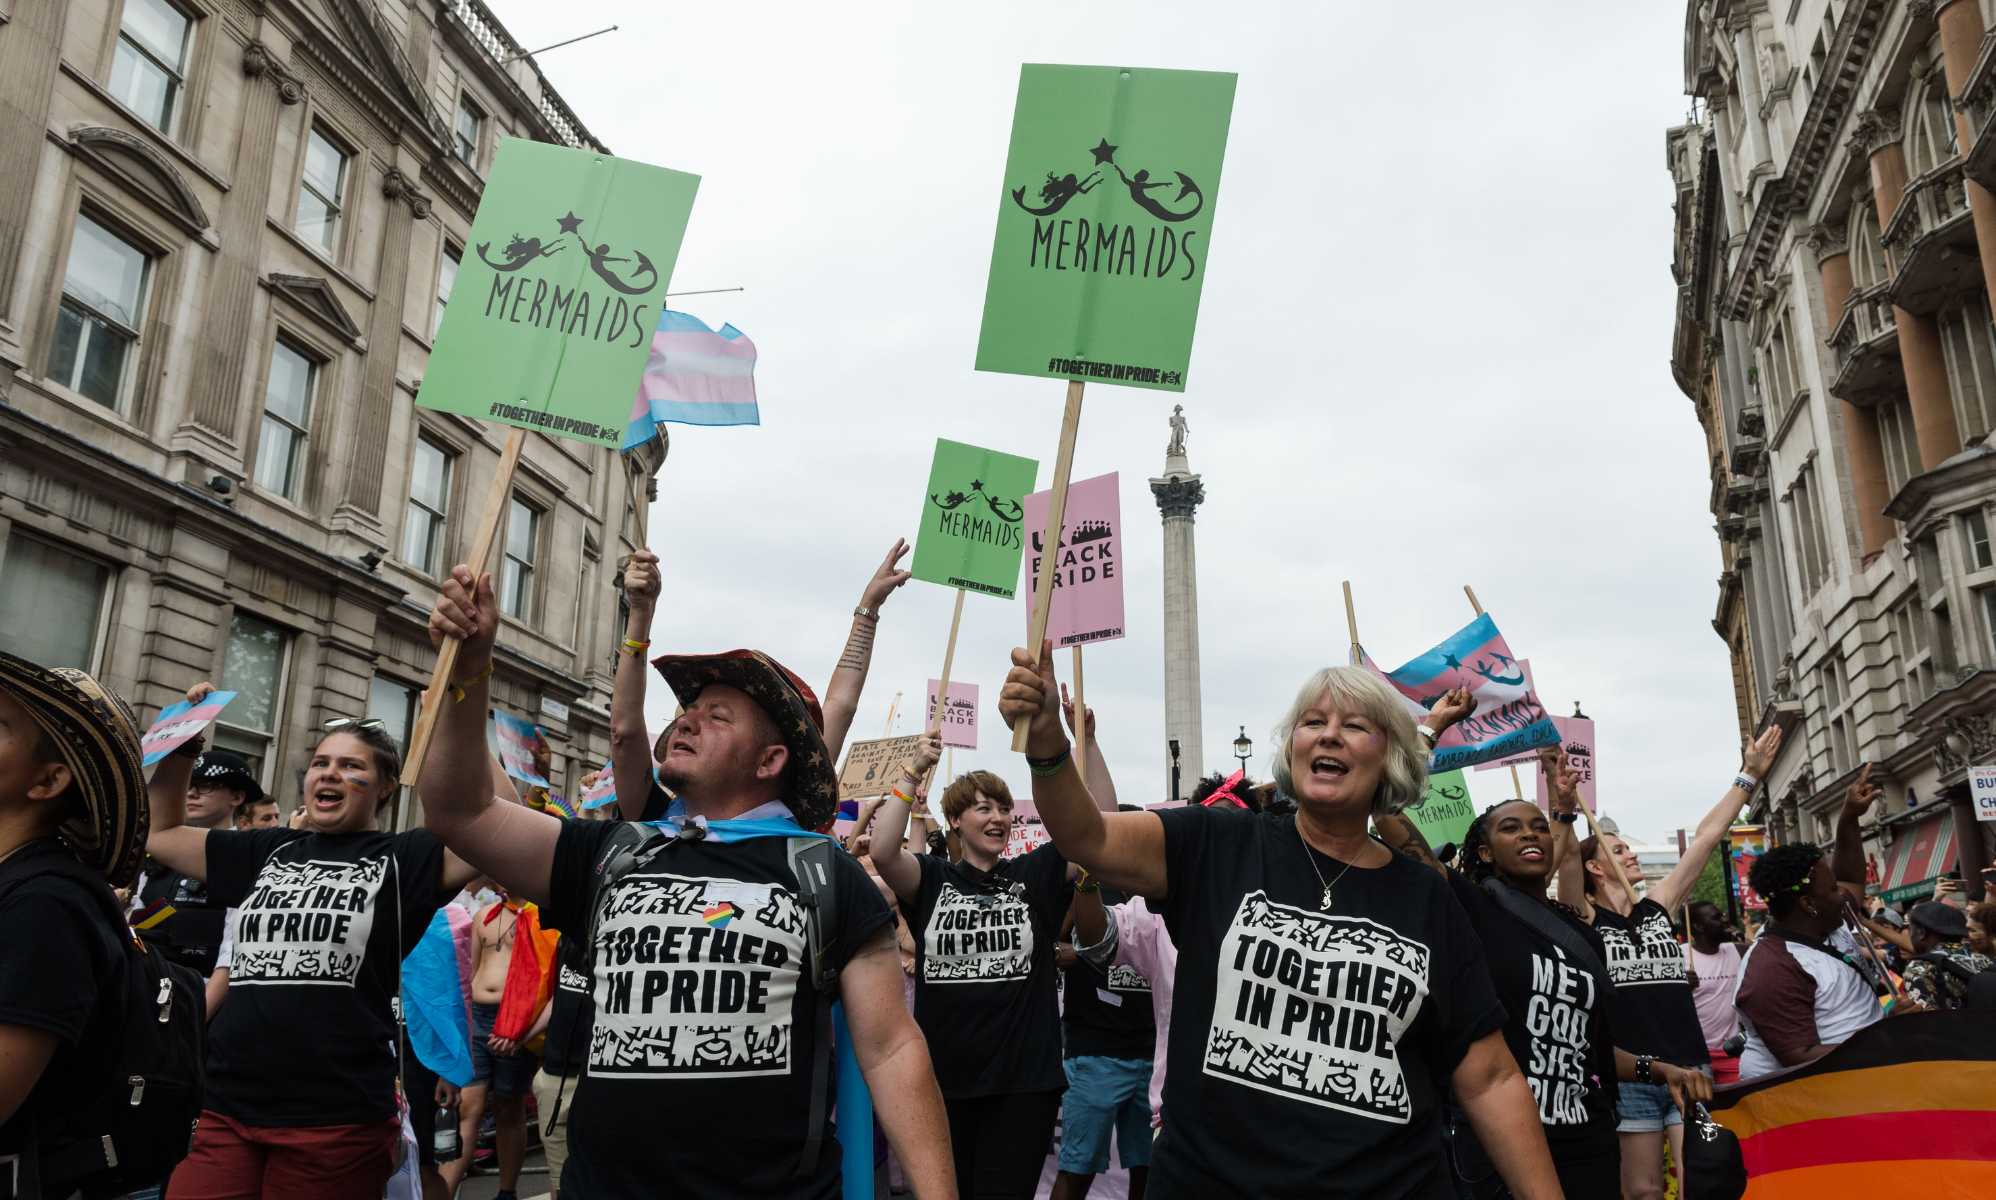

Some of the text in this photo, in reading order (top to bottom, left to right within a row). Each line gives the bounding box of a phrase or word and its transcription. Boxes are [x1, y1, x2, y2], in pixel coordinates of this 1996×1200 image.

[1030, 217, 1197, 282] MERMAIDS
[484, 272, 649, 349] MERMAIDS
[939, 510, 1021, 550] MERMAIDS
[1417, 799, 1472, 825] MERMAIDS
[240, 912, 351, 944] IN PRIDE
[935, 907, 1025, 931] TOGETHER
[597, 925, 789, 968] TOGETHER
[937, 927, 1022, 956] IN PRIDE
[1611, 945, 1631, 961] IN
[605, 969, 772, 1015] IN PRIDE
[1233, 933, 1417, 1021] TOGETHER
[1532, 953, 1595, 1010] MET
[1234, 979, 1394, 1060] IN PRIDE
[1526, 994, 1590, 1050] GOD
